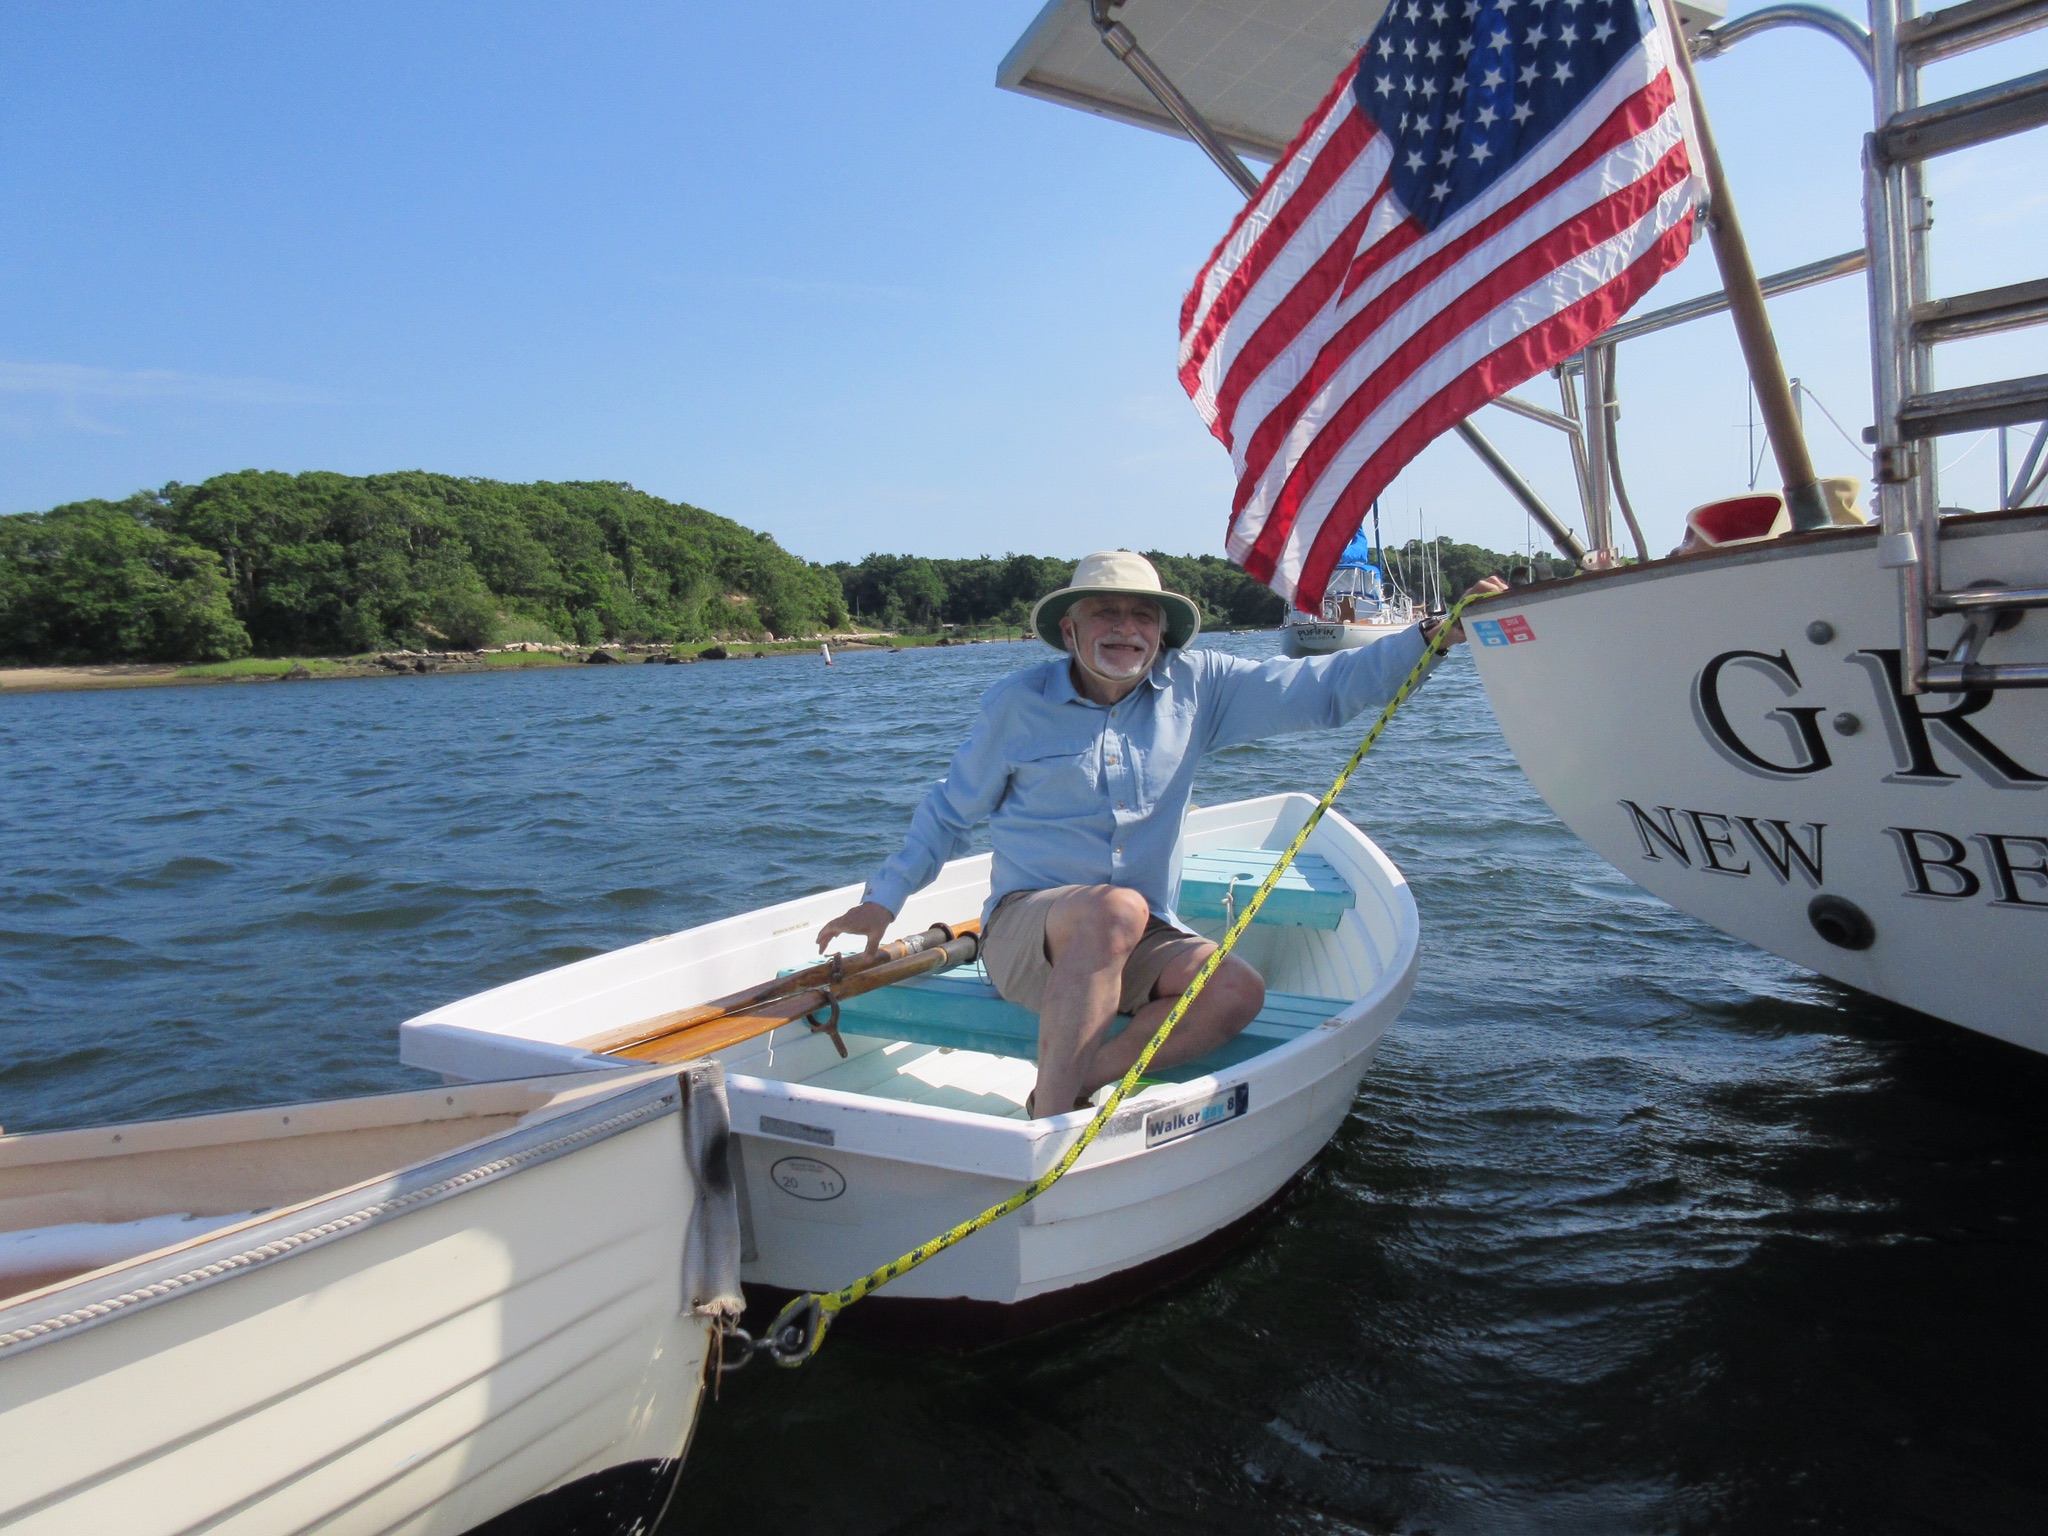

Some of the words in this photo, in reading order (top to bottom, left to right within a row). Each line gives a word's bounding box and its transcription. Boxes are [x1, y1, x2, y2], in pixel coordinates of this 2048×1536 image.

[1297, 628, 1335, 637] PUFFIN
[1619, 799, 1829, 889] NEW
[1880, 827, 2048, 911] BE
[1150, 1111, 1201, 1137] Walker
[1227, 1097, 1235, 1111] 8
[783, 1176, 799, 1189] 20
[821, 1181, 834, 1192] 11
